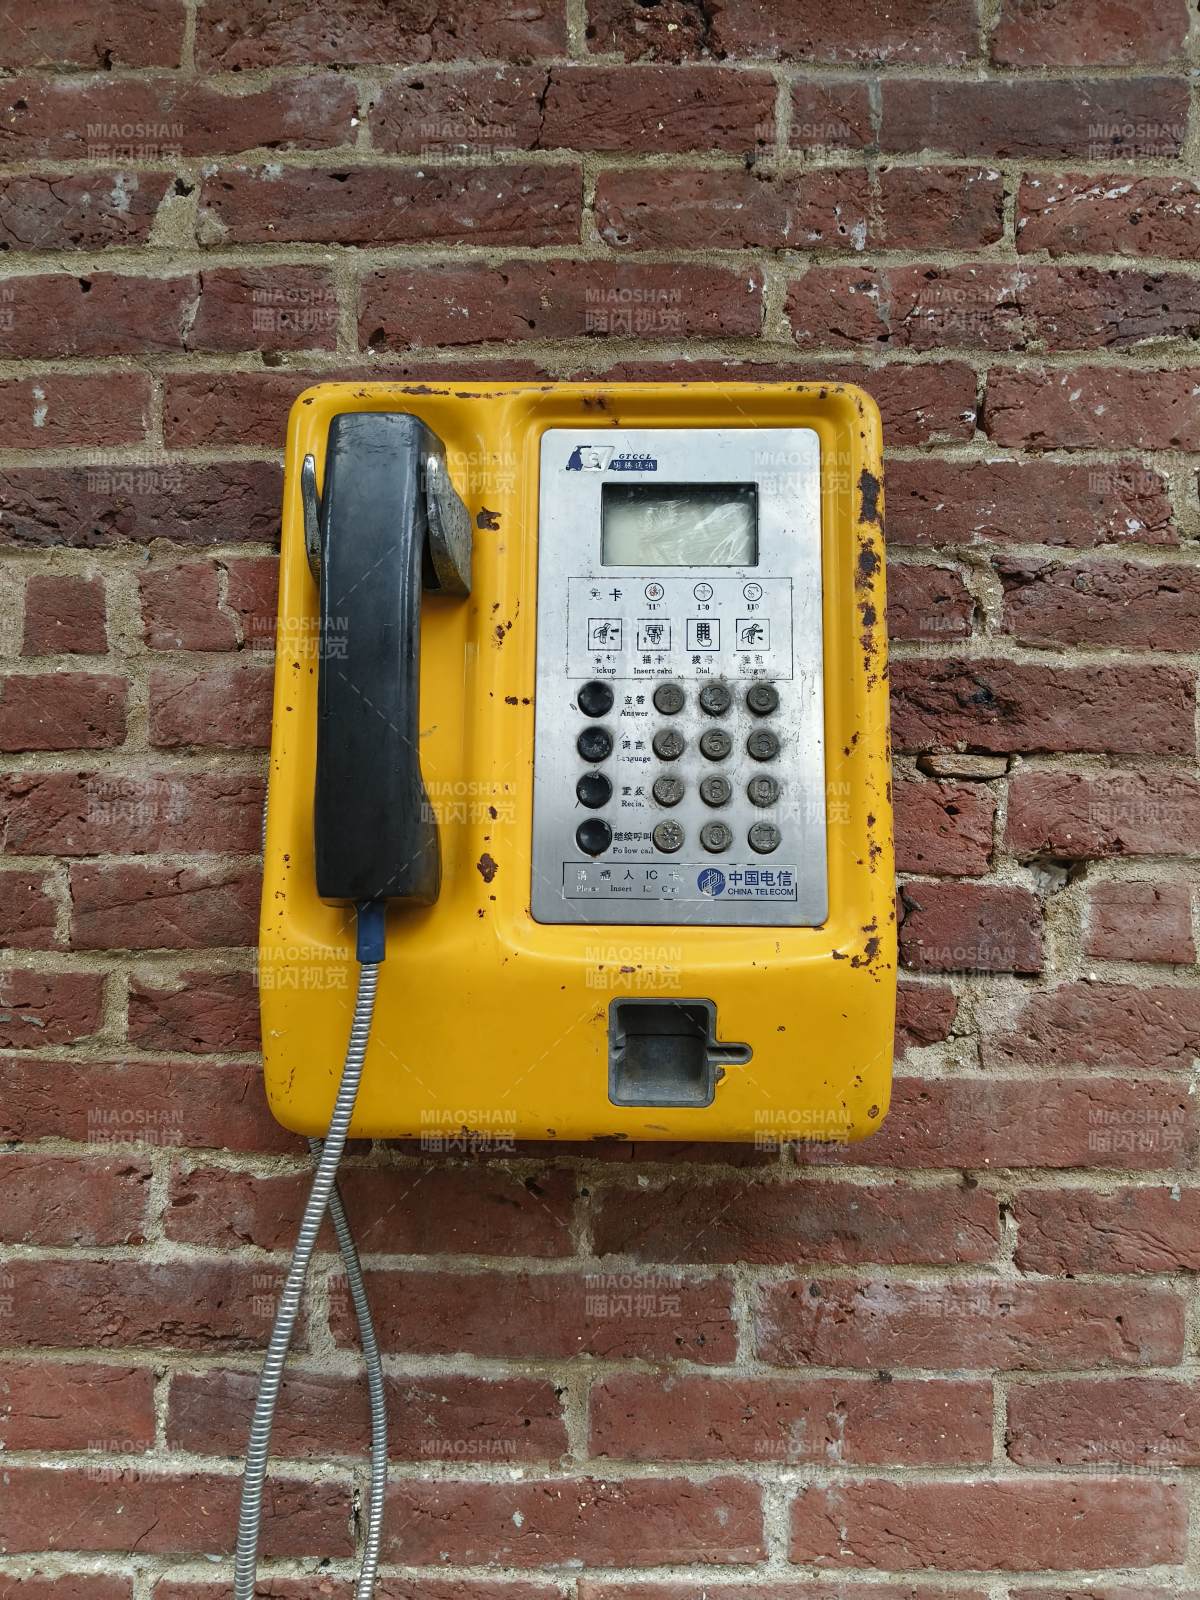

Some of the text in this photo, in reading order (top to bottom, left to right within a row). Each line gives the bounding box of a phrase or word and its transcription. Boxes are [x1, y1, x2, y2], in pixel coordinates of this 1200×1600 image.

[592, 666, 616, 675] ickup
[728, 870, 793, 887] 中国电信
[609, 884, 632, 892] Insert
[755, 888, 794, 896] TELECOM
